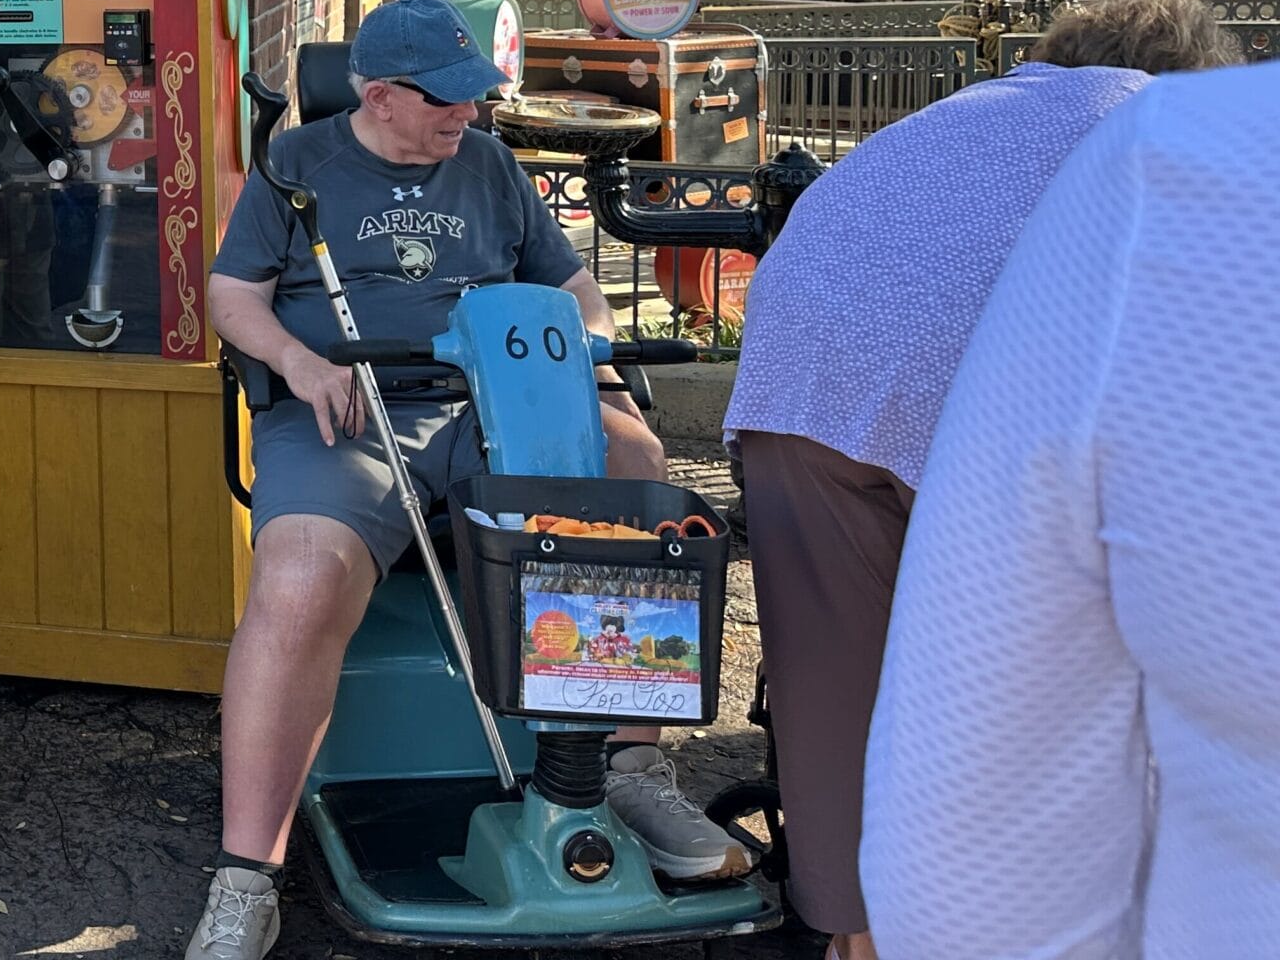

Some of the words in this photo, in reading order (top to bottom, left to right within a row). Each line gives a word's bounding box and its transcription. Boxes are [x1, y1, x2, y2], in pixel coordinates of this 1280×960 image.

[630, 8, 653, 16] POWER
[128, 89, 151, 99] YOUR
[356, 208, 466, 241] ARMY
